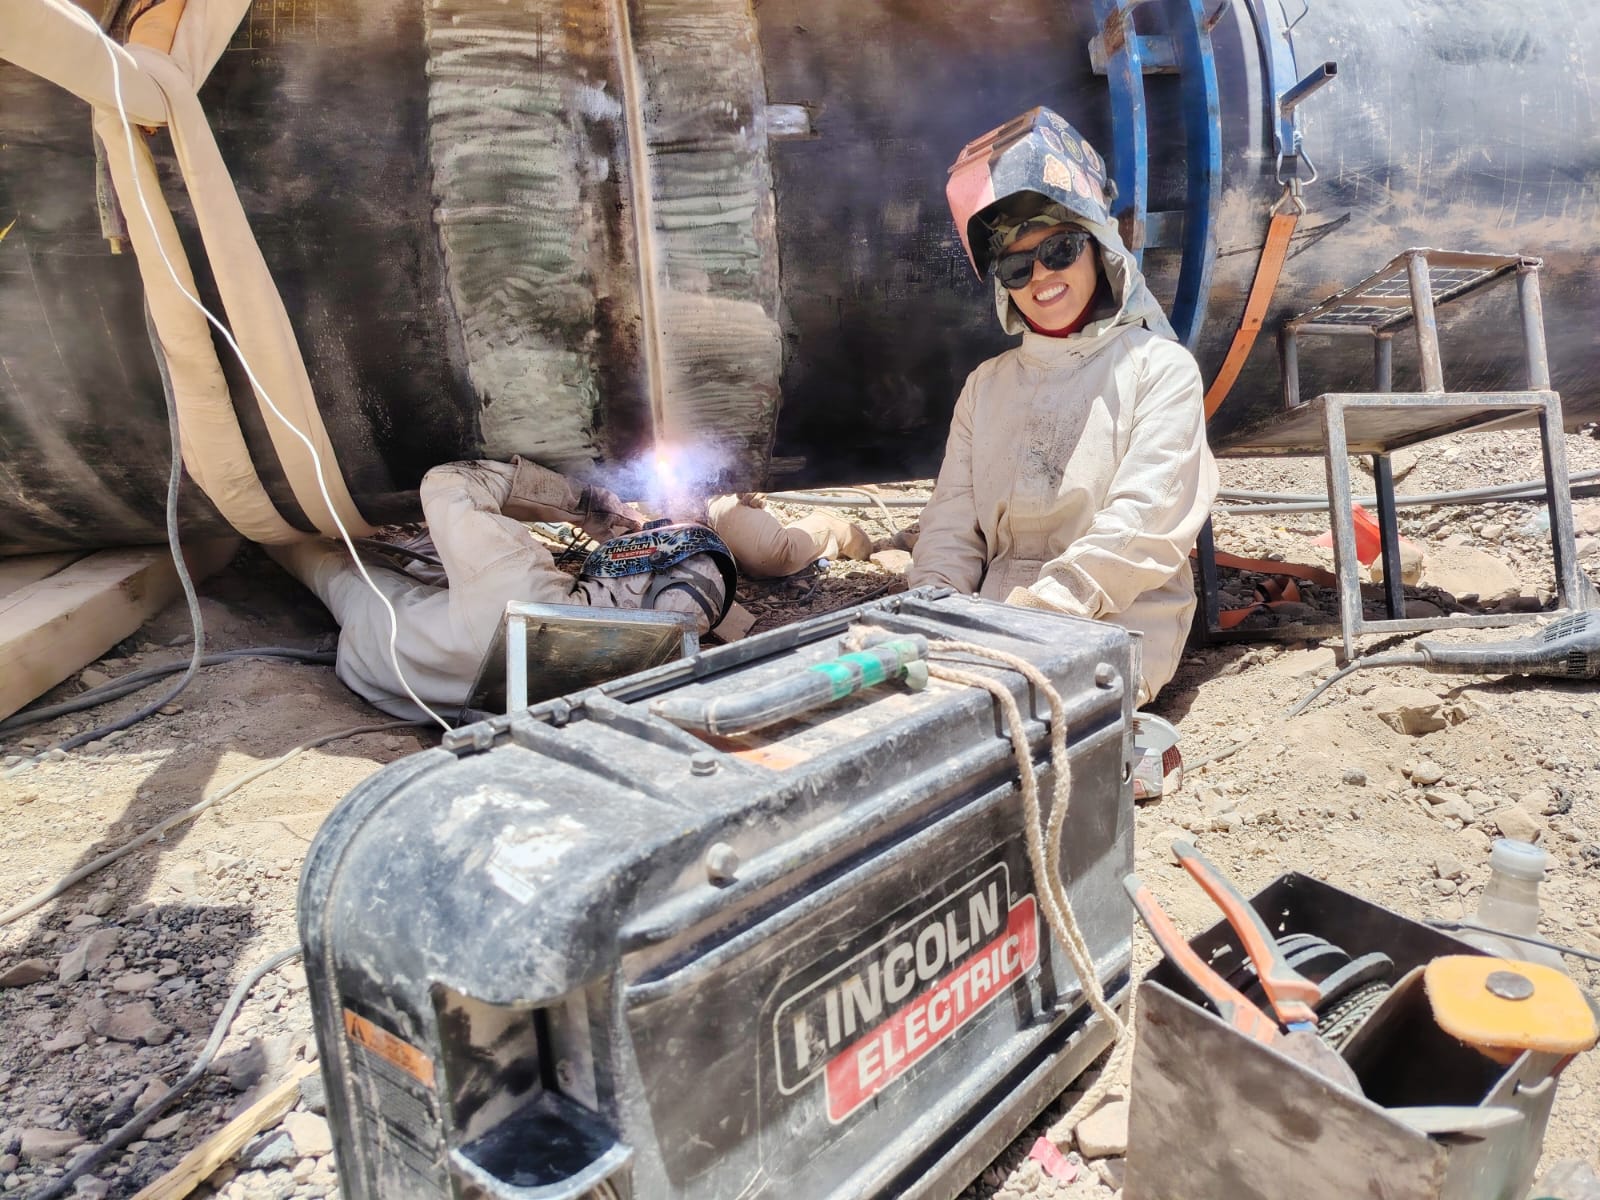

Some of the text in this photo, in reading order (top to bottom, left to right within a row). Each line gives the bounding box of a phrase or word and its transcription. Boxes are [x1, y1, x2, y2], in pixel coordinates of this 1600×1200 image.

[607, 543, 650, 554] LINCOLN
[616, 549, 652, 559] ELECTRIC
[793, 881, 999, 1070] LINCOLN
[857, 934, 1021, 1090] ELECTRIC
